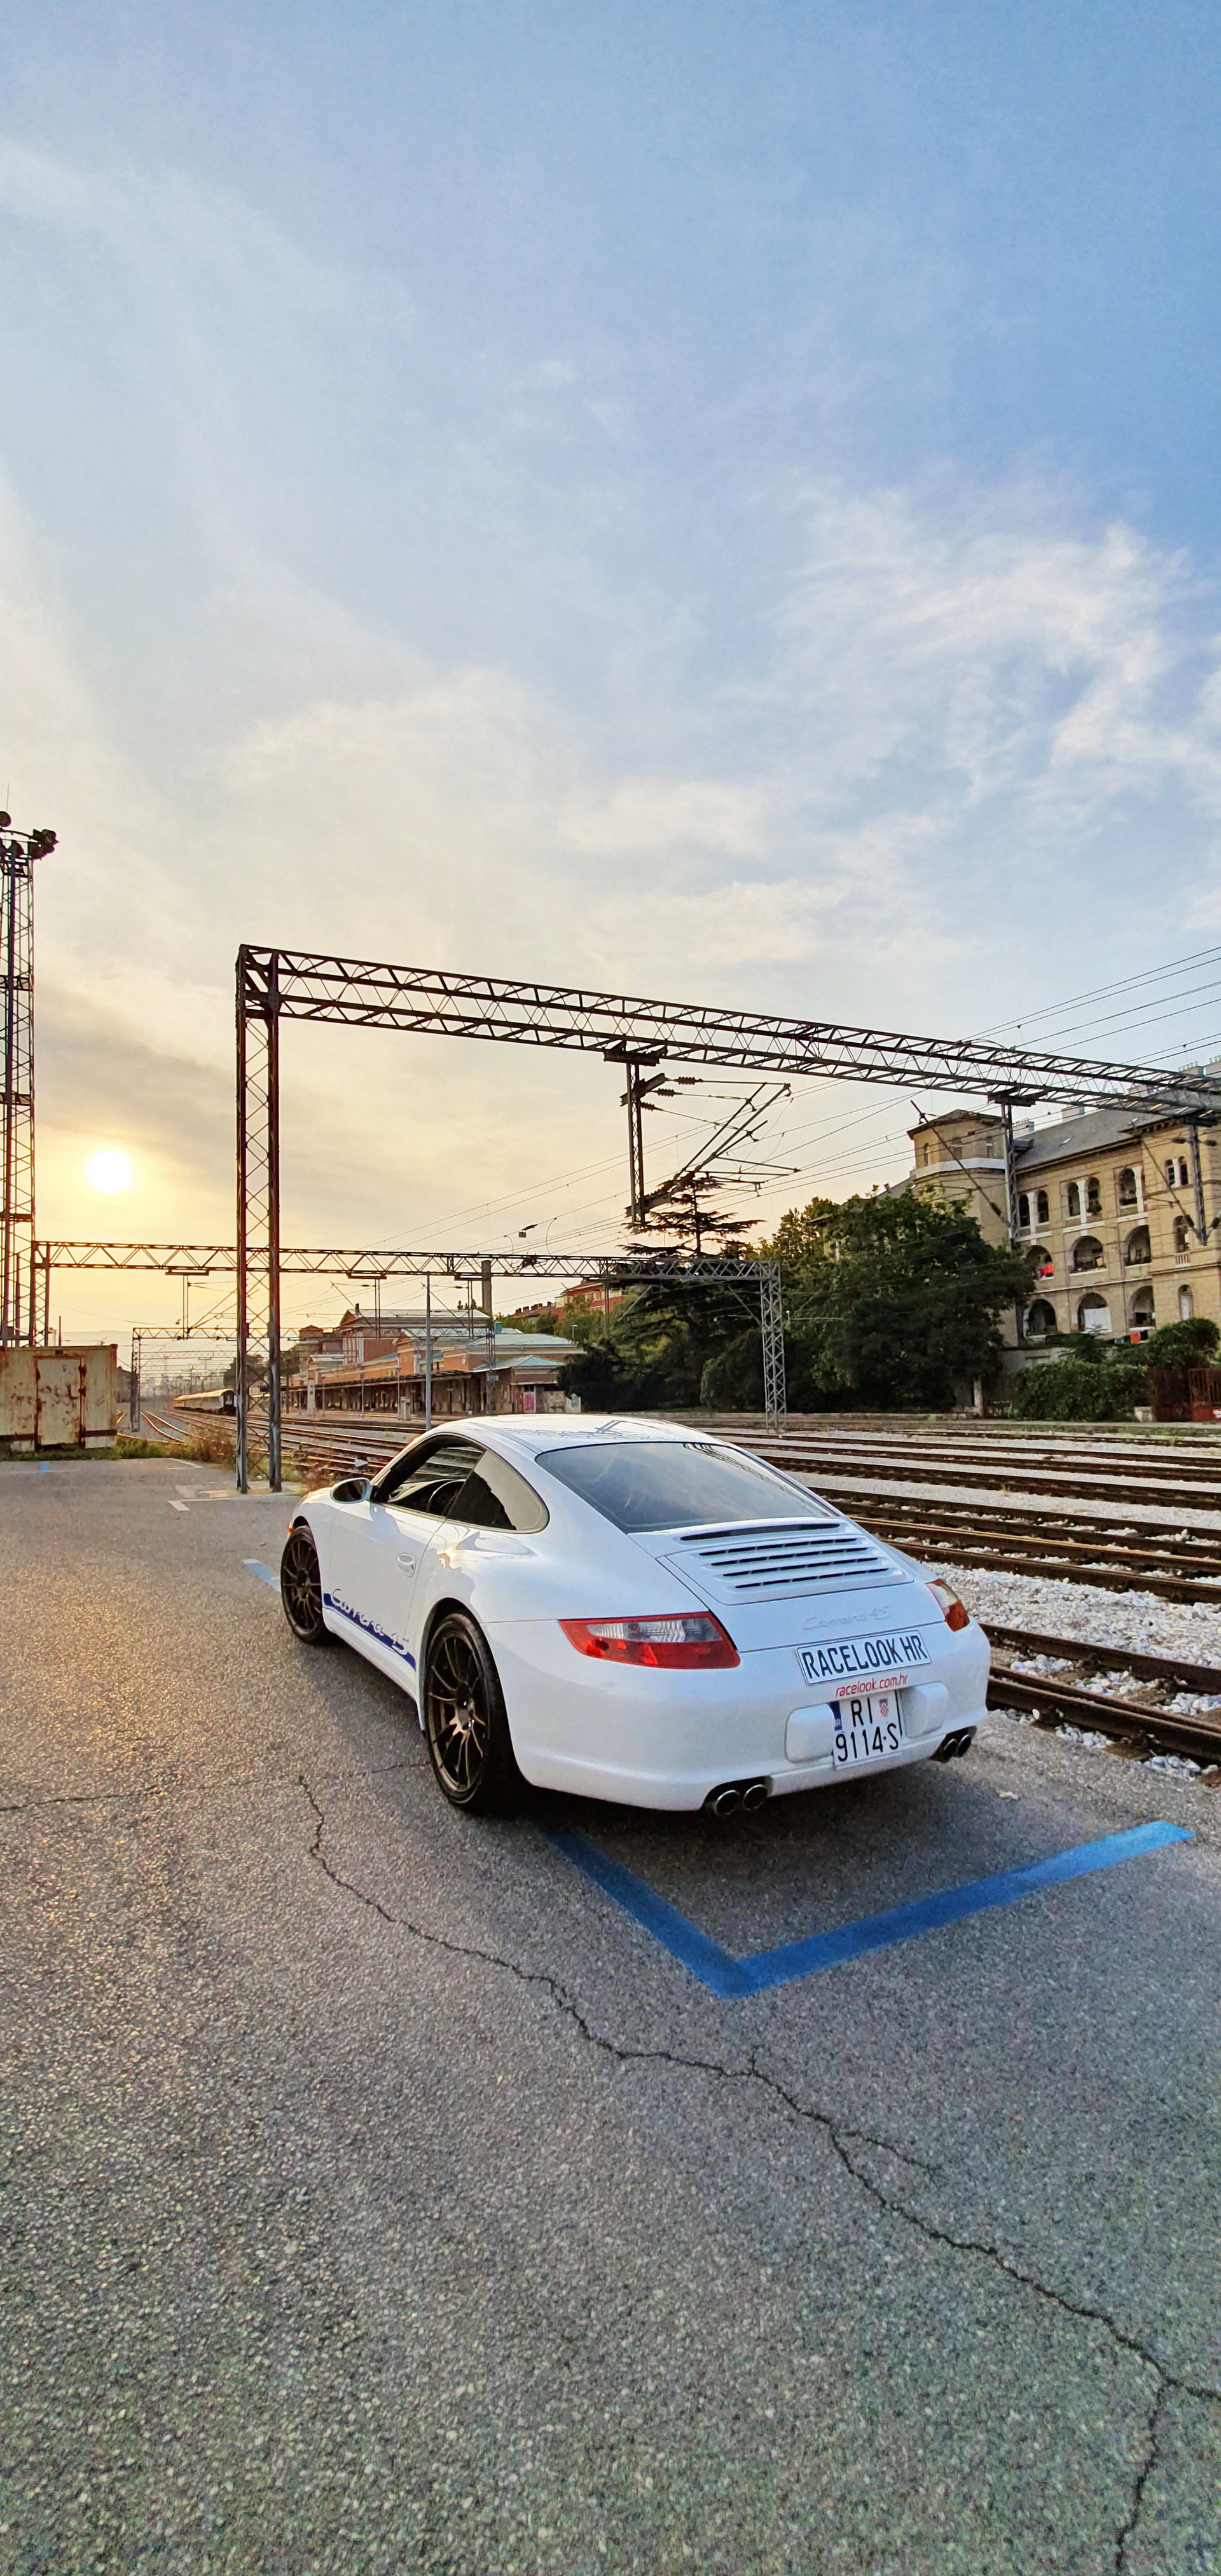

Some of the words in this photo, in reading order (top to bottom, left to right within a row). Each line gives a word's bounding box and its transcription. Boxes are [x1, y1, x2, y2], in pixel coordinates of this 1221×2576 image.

[801, 1637, 904, 1679] RACELOOK
[899, 1635, 928, 1662] HR
[835, 1672, 908, 1698] racelook.com.hr
[850, 1697, 873, 1727] RI
